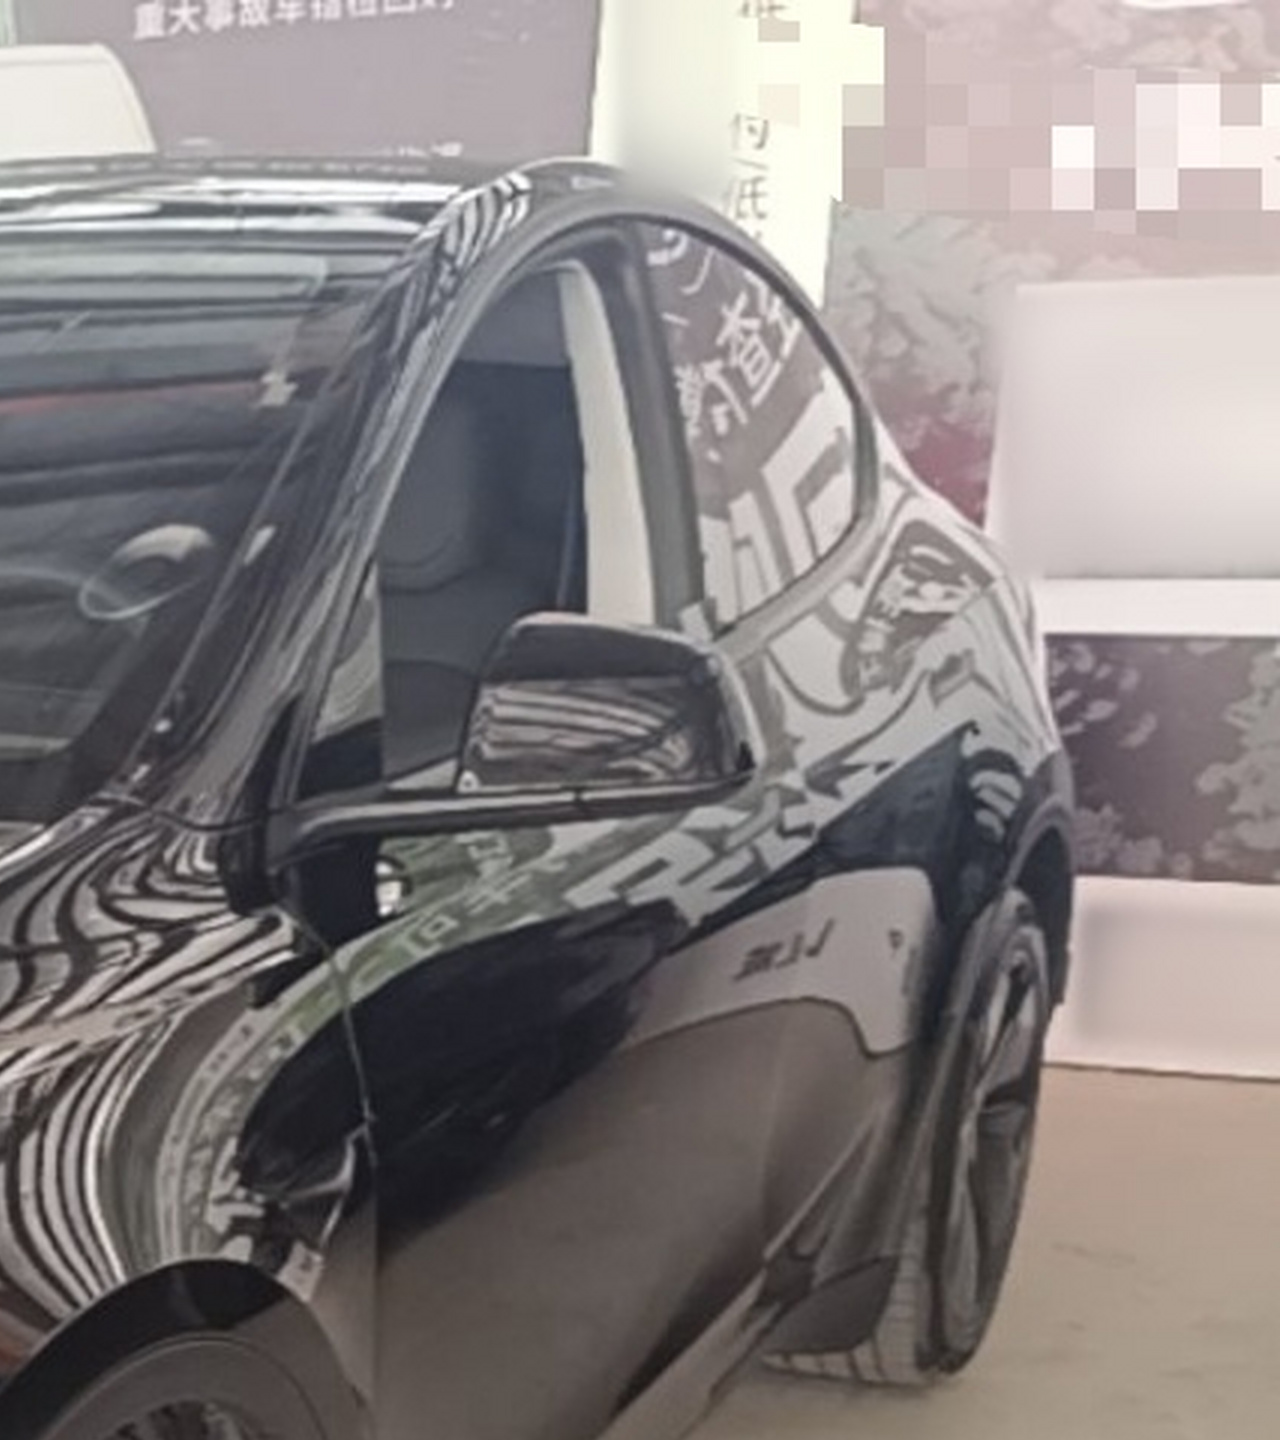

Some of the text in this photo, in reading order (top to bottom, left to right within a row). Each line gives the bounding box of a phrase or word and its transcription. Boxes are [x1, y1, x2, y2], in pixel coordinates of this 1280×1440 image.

[134, 0, 454, 39] 重大事故车
